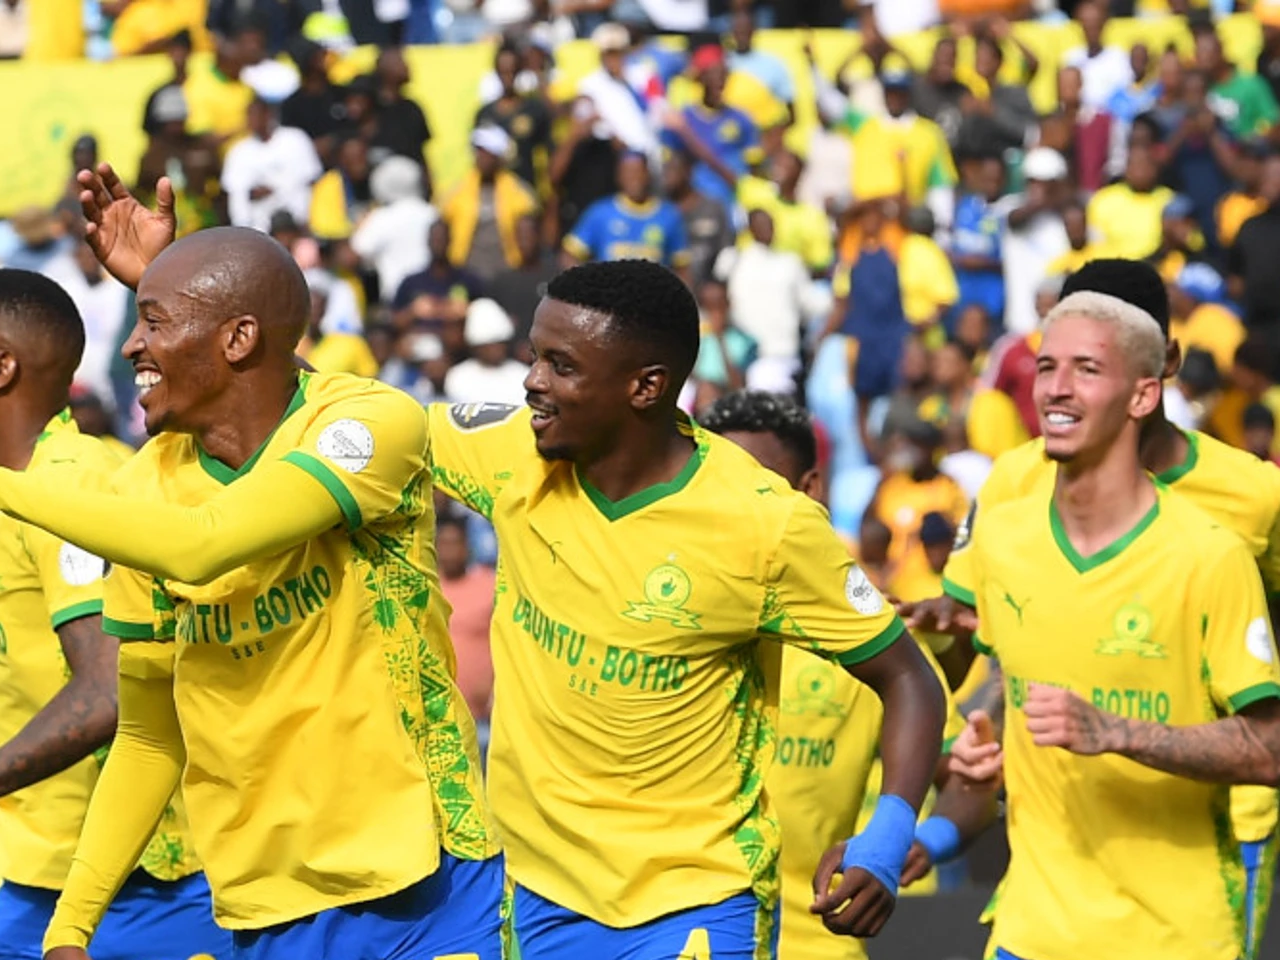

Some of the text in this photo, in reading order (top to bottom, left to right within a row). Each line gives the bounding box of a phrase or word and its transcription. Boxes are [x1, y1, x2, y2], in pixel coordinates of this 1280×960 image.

[254, 565, 331, 634] BOTHO
[600, 645, 689, 692] BOTHO
[776, 735, 835, 767] OTHO
